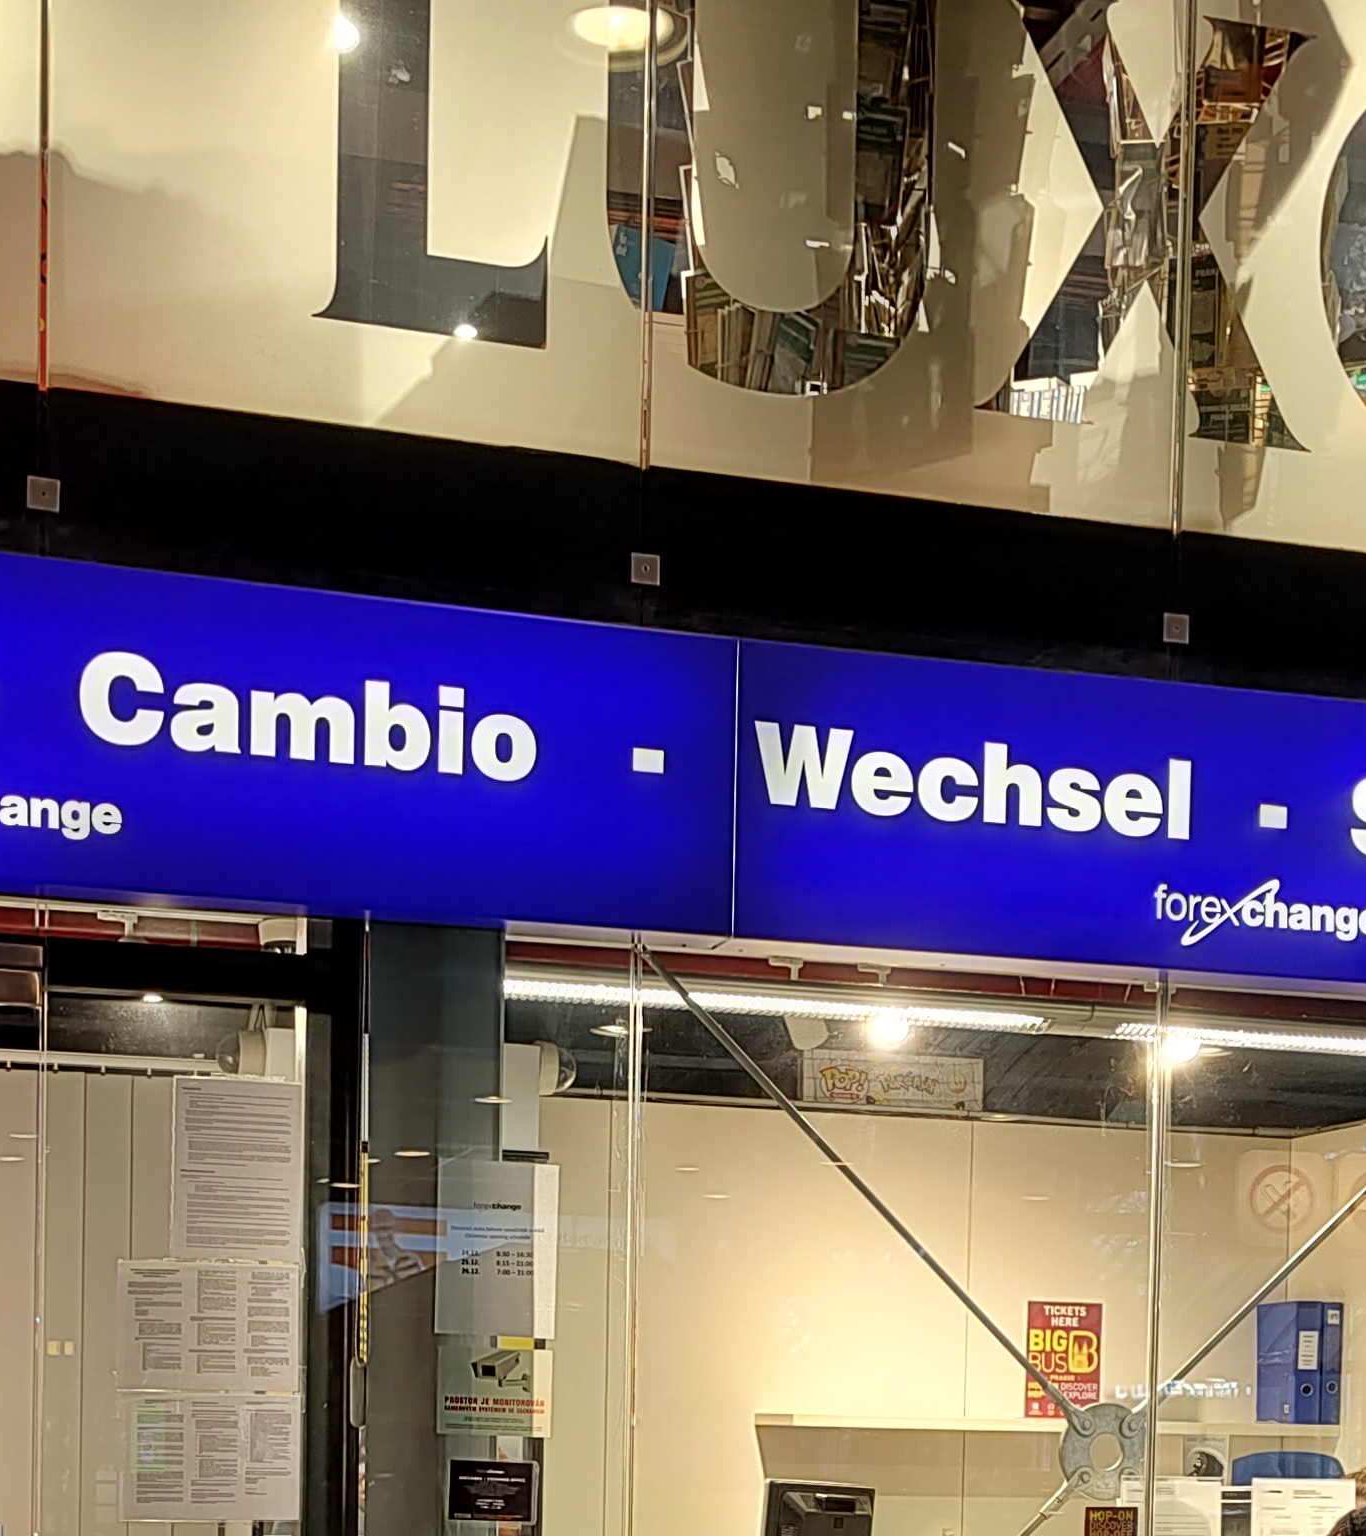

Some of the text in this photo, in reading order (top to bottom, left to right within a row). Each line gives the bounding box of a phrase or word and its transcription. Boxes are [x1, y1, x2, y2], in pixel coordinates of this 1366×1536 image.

[79, 650, 539, 784] Cambio
[754, 719, 1194, 842] Wechsel
[1043, 1305, 1087, 1316] TICKETS
[1051, 1317, 1079, 1327] HERE
[1029, 1329, 1068, 1351] BIG
[1028, 1352, 1067, 1373] BUS
[1060, 1382, 1098, 1392] DISCOVER
[1089, 1510, 1134, 1521] HOP-ON
[1089, 1521, 1134, 1530] DISCOVER
